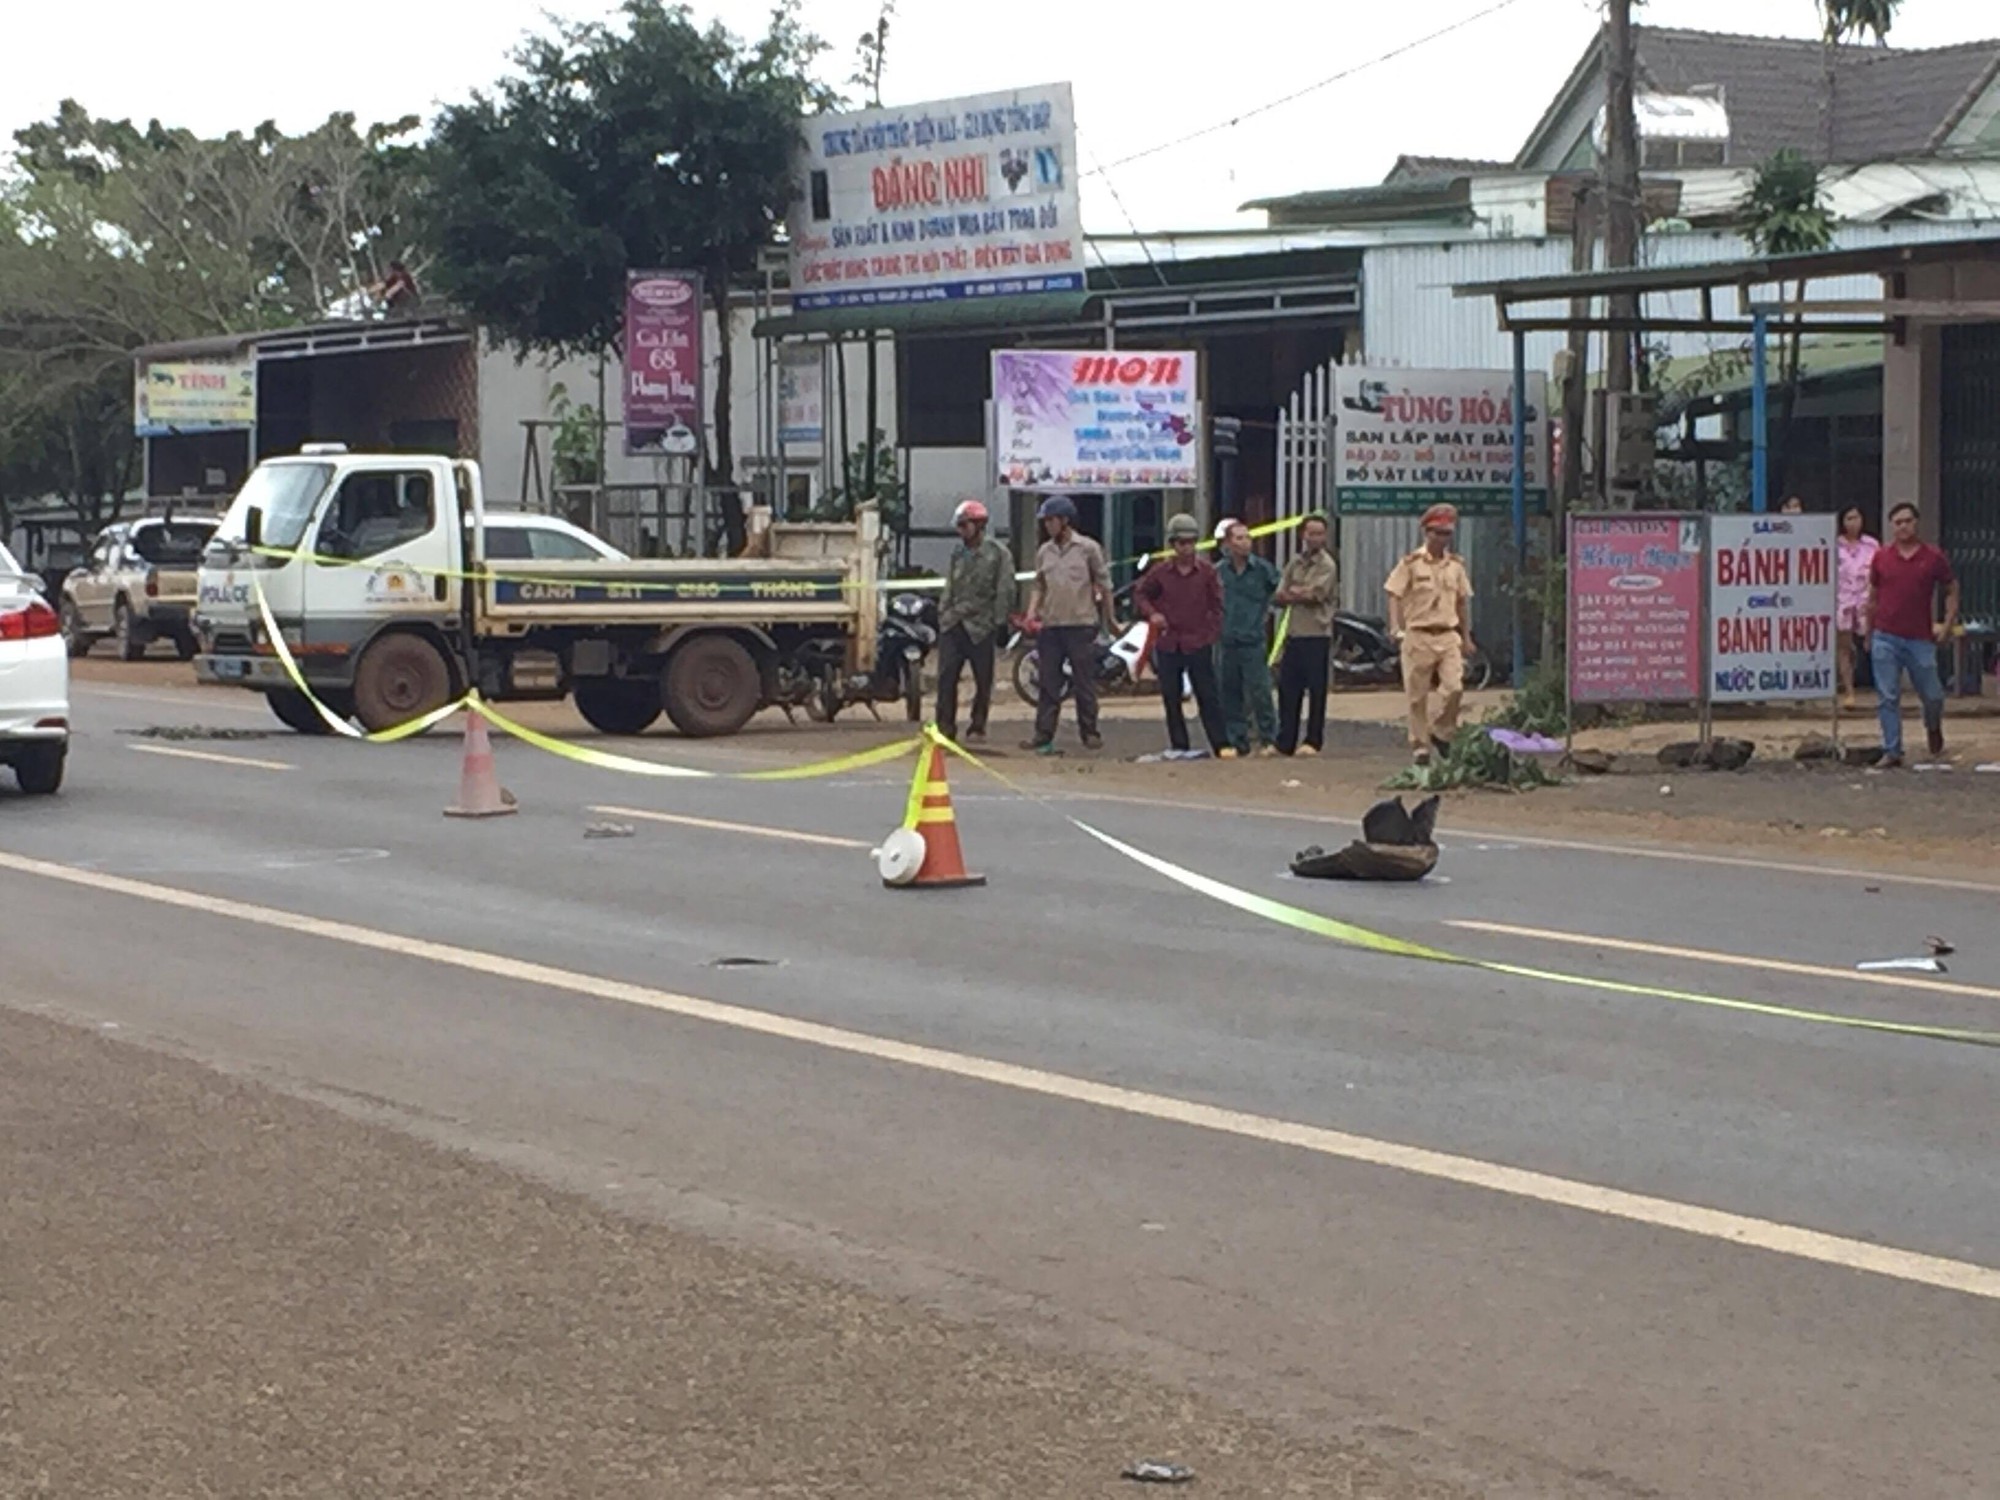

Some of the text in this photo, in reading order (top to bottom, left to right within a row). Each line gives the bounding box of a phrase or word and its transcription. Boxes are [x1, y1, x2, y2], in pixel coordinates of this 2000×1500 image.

[649, 348, 677, 369] 68
[1380, 387, 1453, 424] TÙNG
[1346, 431, 1384, 444] SAN
[1390, 427, 1428, 445] LẤP
[1454, 467, 1485, 482] XÂY
[1717, 538, 1829, 586] BÁNH MÌ
[1717, 606, 1831, 662] BÁNH KHỌT
[1715, 664, 1756, 692] NƯỚC
[1792, 663, 1831, 690] KHÁT
